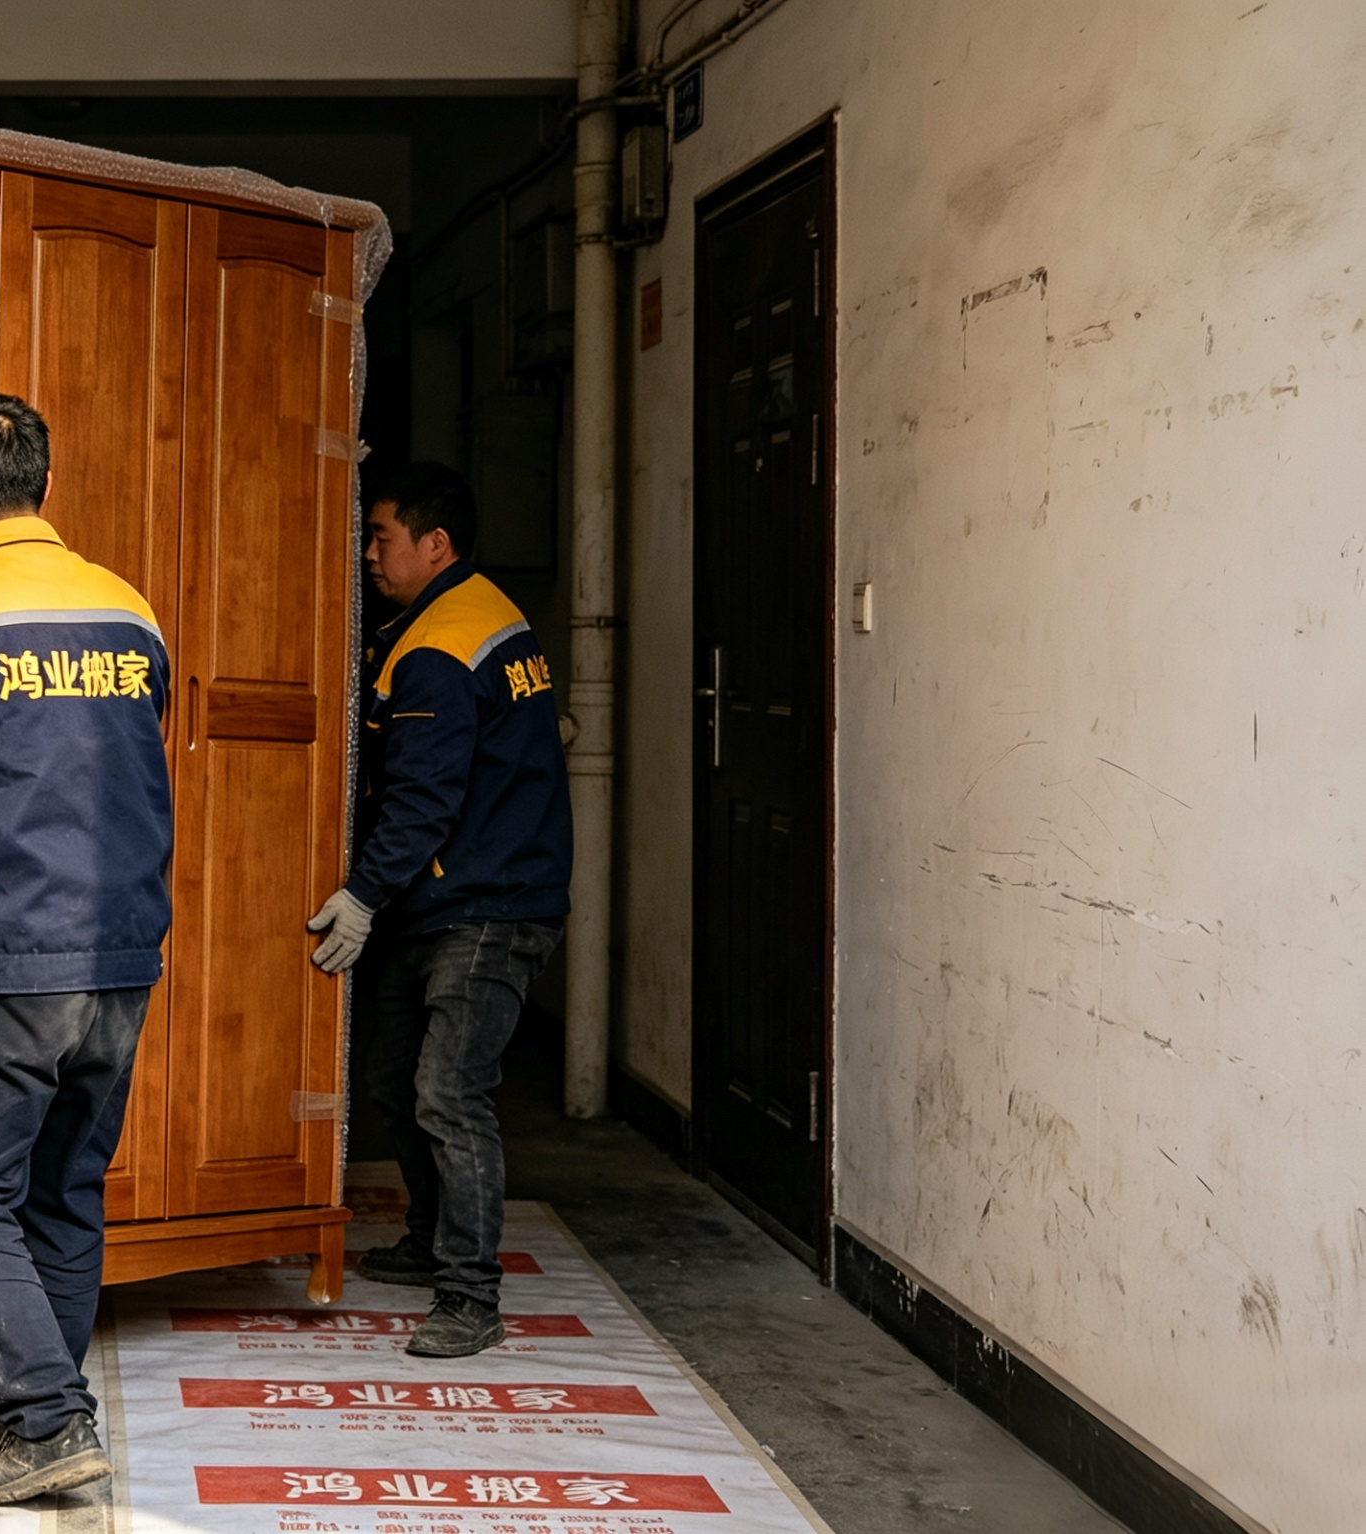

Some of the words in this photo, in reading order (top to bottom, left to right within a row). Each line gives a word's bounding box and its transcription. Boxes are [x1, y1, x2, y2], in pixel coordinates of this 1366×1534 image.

[263, 1384, 576, 1409] 鸿业搬家
[282, 1471, 639, 1505] 鸿业搬家
